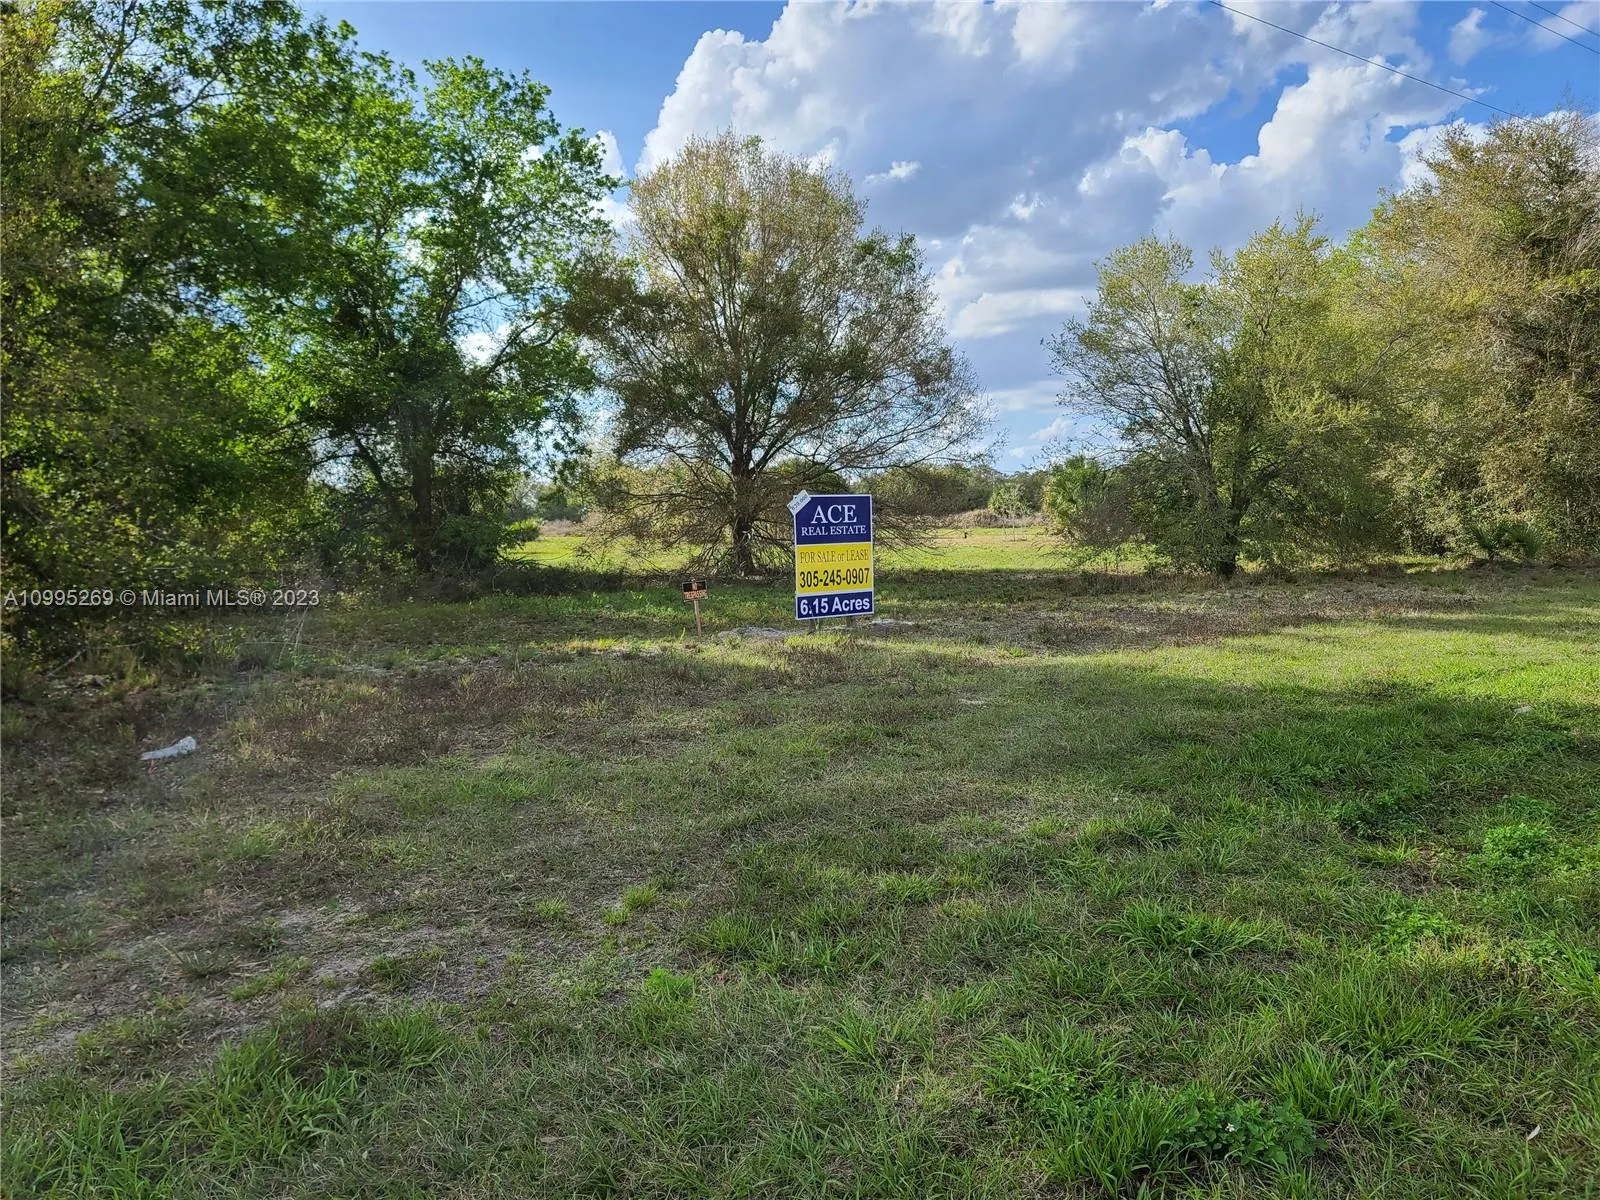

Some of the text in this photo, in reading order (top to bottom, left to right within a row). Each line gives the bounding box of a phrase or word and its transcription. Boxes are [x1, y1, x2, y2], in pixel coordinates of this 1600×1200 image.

[811, 505, 857, 524] ACE
[801, 525, 867, 536] REAL ESTATE
[800, 549, 869, 564] FOR SALE or LEASE
[799, 567, 870, 588] 305-245-0907
[800, 596, 870, 615] 6.15 Acres
